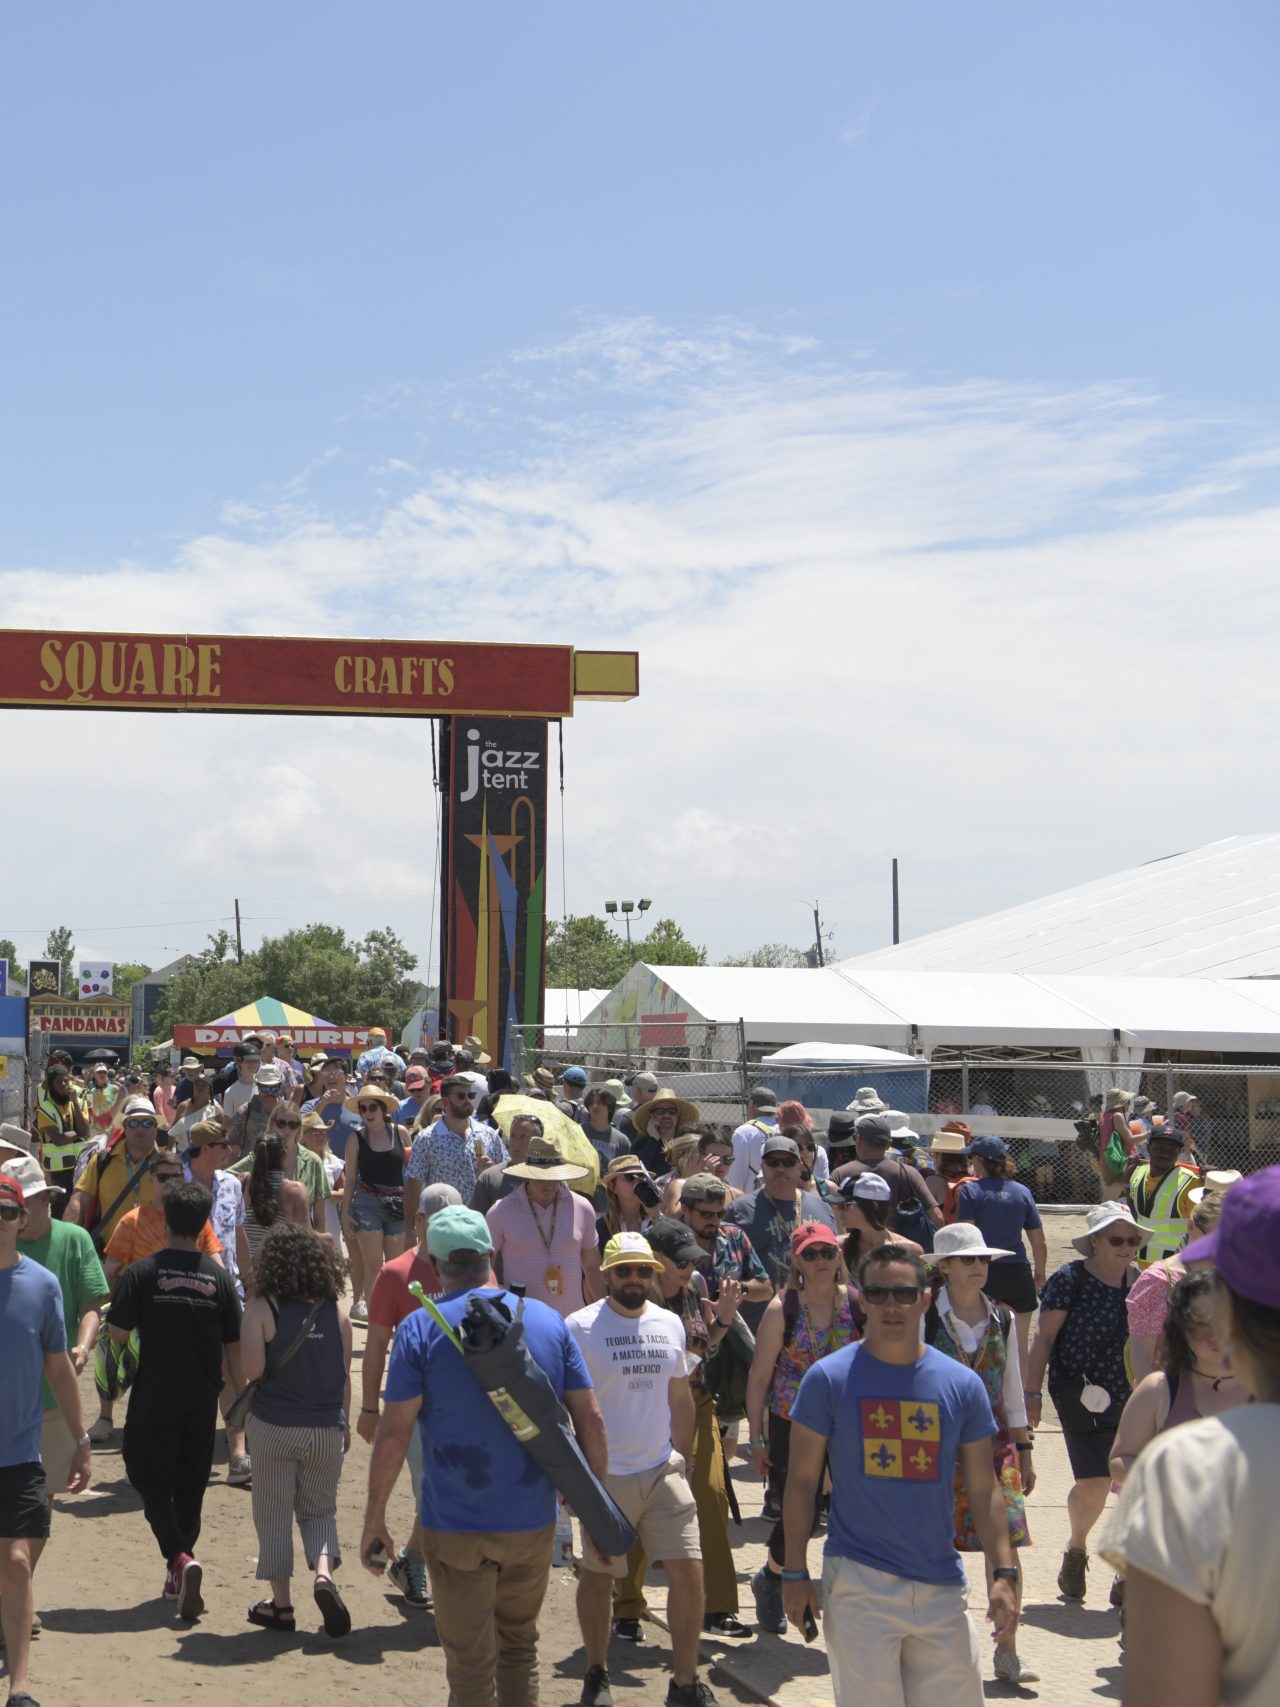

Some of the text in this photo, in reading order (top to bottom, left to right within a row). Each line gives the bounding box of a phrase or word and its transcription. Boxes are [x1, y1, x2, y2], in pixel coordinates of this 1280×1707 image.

[39, 639, 221, 703] SQUARE
[334, 655, 455, 696] CRAFTS
[485, 740, 497, 748] the
[460, 728, 540, 802] jazz
[481, 768, 529, 789] tent
[40, 1016, 127, 1033] BANDANAS
[194, 1029, 369, 1045] DAUIRIS
[604, 1335, 637, 1347] TEQUILA
[638, 1335, 645, 1344] &
[612, 1348, 669, 1361] A MATCH MADE
[622, 1363, 661, 1376] IN MEXICO
